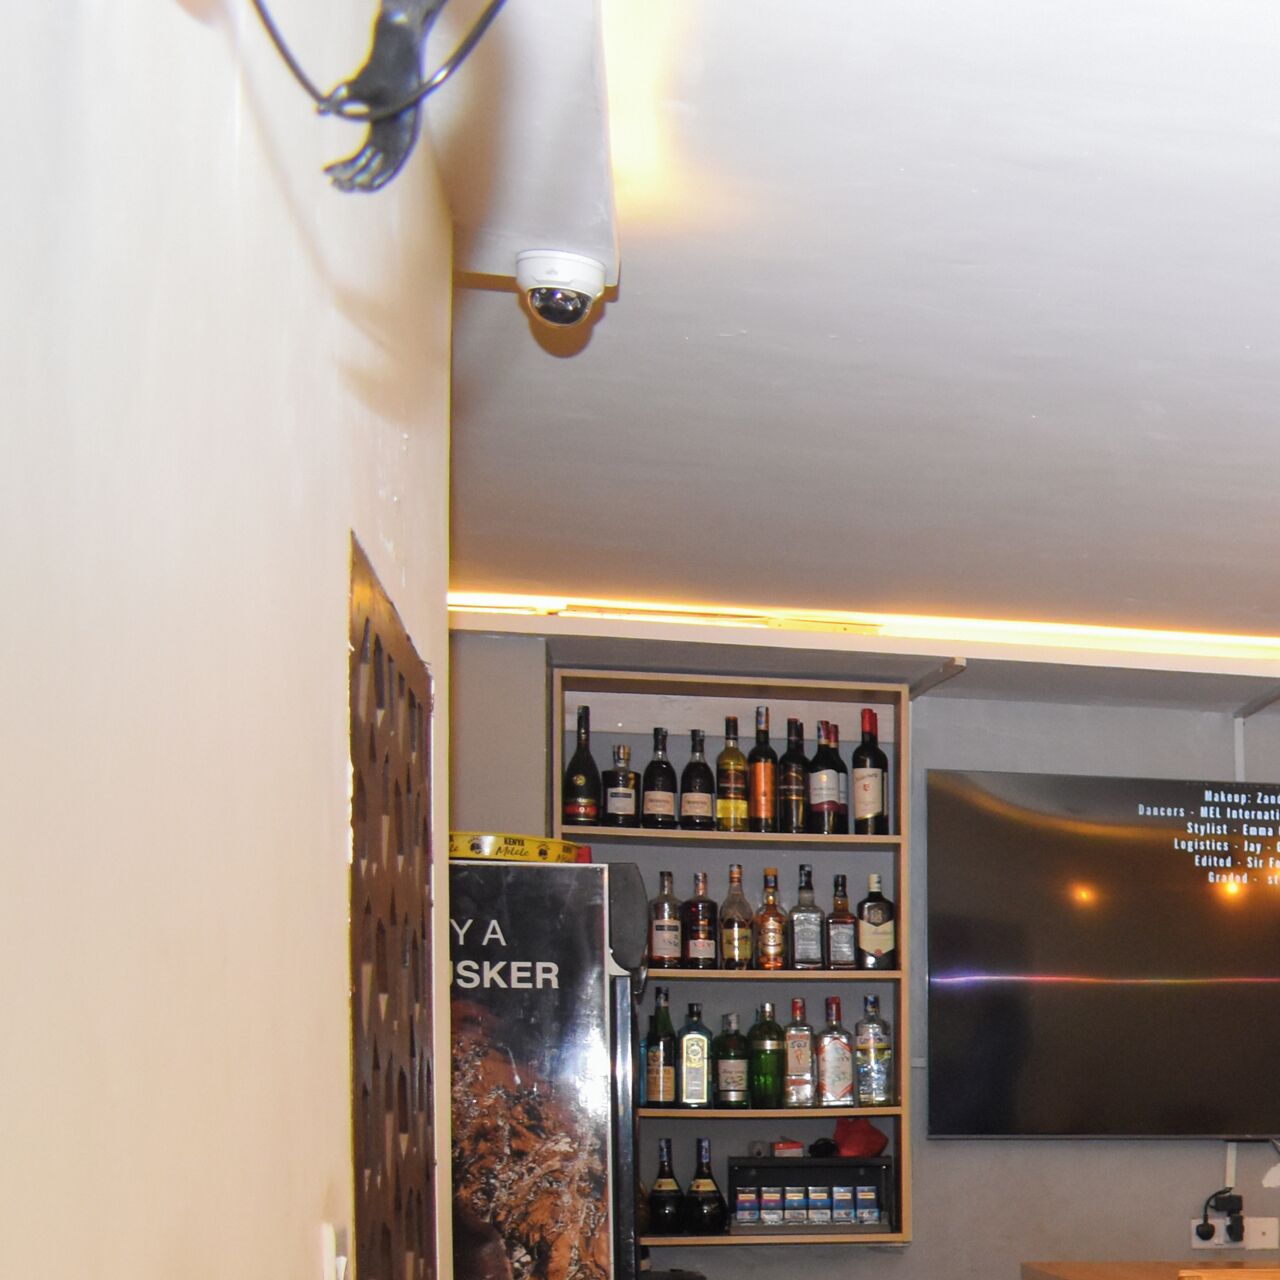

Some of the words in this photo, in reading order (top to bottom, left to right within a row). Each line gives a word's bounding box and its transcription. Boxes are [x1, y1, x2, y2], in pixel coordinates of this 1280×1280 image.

[1204, 790, 1251, 805] Makeup:
[1138, 804, 1185, 817] Dancers
[1200, 806, 1221, 819] MEL
[1186, 822, 1228, 836] Stylist
[1243, 824, 1274, 837] Emma
[503, 837, 525, 847] KENYA
[1174, 838, 1229, 853] Logistics
[1195, 855, 1232, 868] Edited
[1247, 856, 1264, 868] Sir
[1208, 871, 1248, 884] Graded
[481, 919, 507, 946] A
[449, 959, 560, 989] SKER
